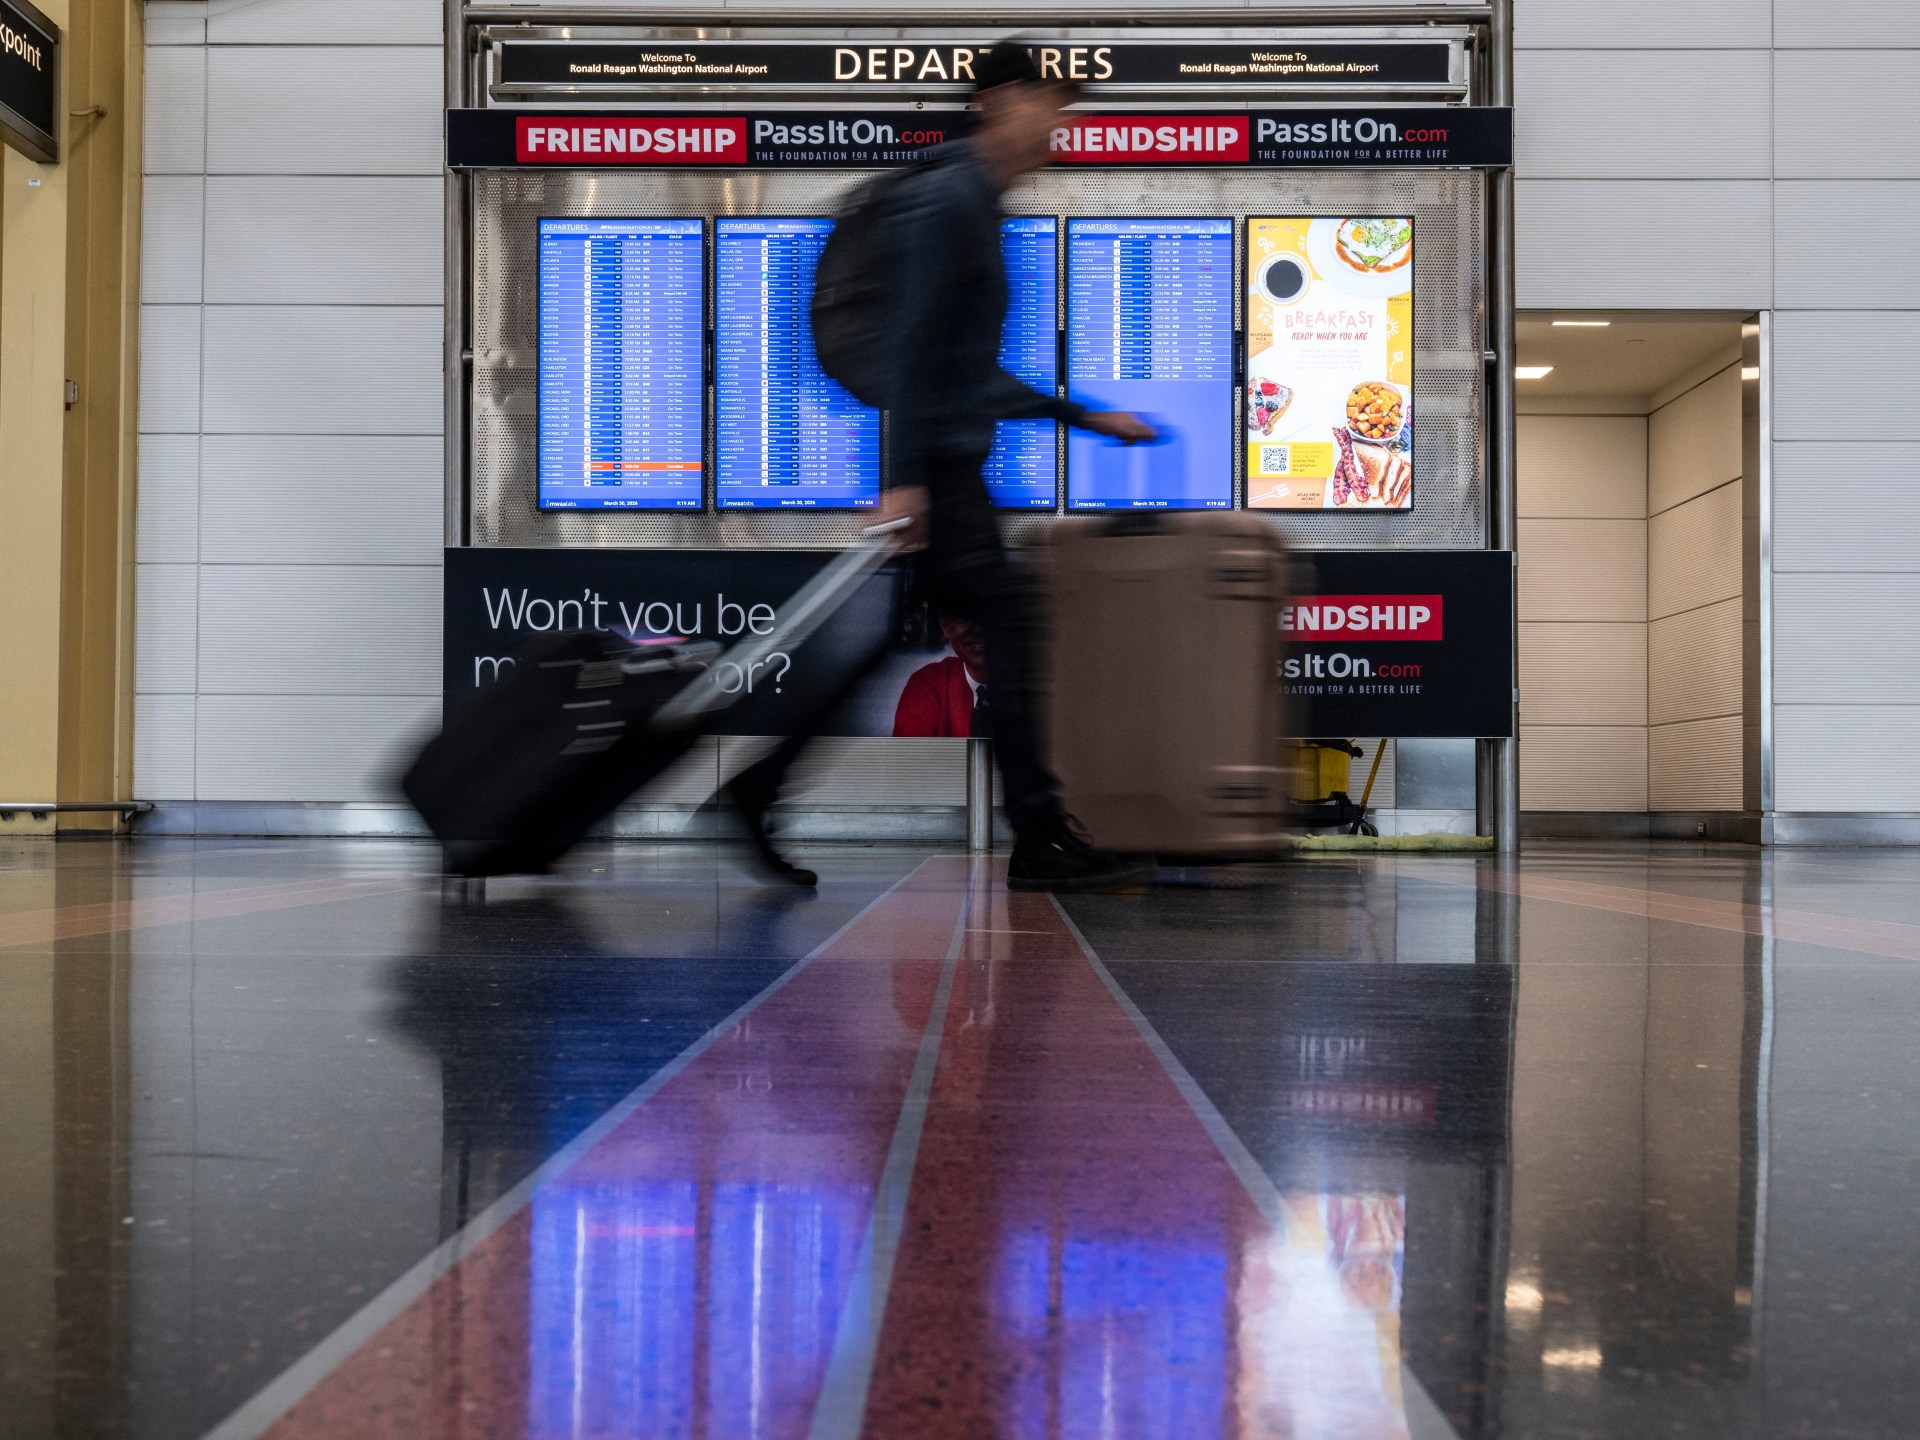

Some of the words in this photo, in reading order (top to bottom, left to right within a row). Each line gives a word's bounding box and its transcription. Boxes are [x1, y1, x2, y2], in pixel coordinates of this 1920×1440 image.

[641, 53, 682, 62] Welcome
[685, 53, 696, 62] To
[1252, 52, 1293, 61] Welcome
[1295, 52, 1307, 61] To
[570, 64, 601, 73] Ronald
[603, 64, 637, 75] Reagan
[639, 64, 693, 75] Washington
[695, 64, 733, 73] National
[735, 64, 768, 75] Airport
[834, 48, 1113, 80] DEPARRES
[1180, 64, 1211, 73] Ronald
[1213, 64, 1247, 75] Reagan
[1249, 63, 1303, 75] Washington
[1306, 63, 1344, 72] National
[1346, 63, 1379, 75] Airport
[528, 128, 736, 153] FRIENDSHIP
[1051, 127, 1238, 151] RIENDSHIP
[756, 152, 774, 160] THE
[780, 152, 847, 160] FOUNDATION
[852, 152, 867, 160] FOR
[873, 152, 879, 160] A
[884, 152, 919, 160] BETTER
[1258, 150, 1276, 158] THE
[1282, 150, 1350, 158] FOUNDATION
[1355, 150, 1370, 158] FOR
[1376, 150, 1382, 158] A
[1386, 150, 1422, 158] BETTER
[1427, 150, 1447, 158] LIFE
[1286, 310, 1374, 328] BREAKFAST
[1292, 332, 1314, 340] READY
[1317, 332, 1336, 340] WHEN
[1340, 332, 1352, 340] YOU
[1354, 332, 1368, 340] ARE
[483, 587, 608, 631] Won't
[619, 602, 701, 635] you
[718, 593, 777, 635] be
[1279, 606, 1430, 630] ENDSHIP
[475, 656, 516, 687] m
[1328, 686, 1344, 694] FOR
[1348, 686, 1354, 694] A
[1360, 686, 1394, 694] BETTER
[1400, 686, 1420, 694] LIFE
